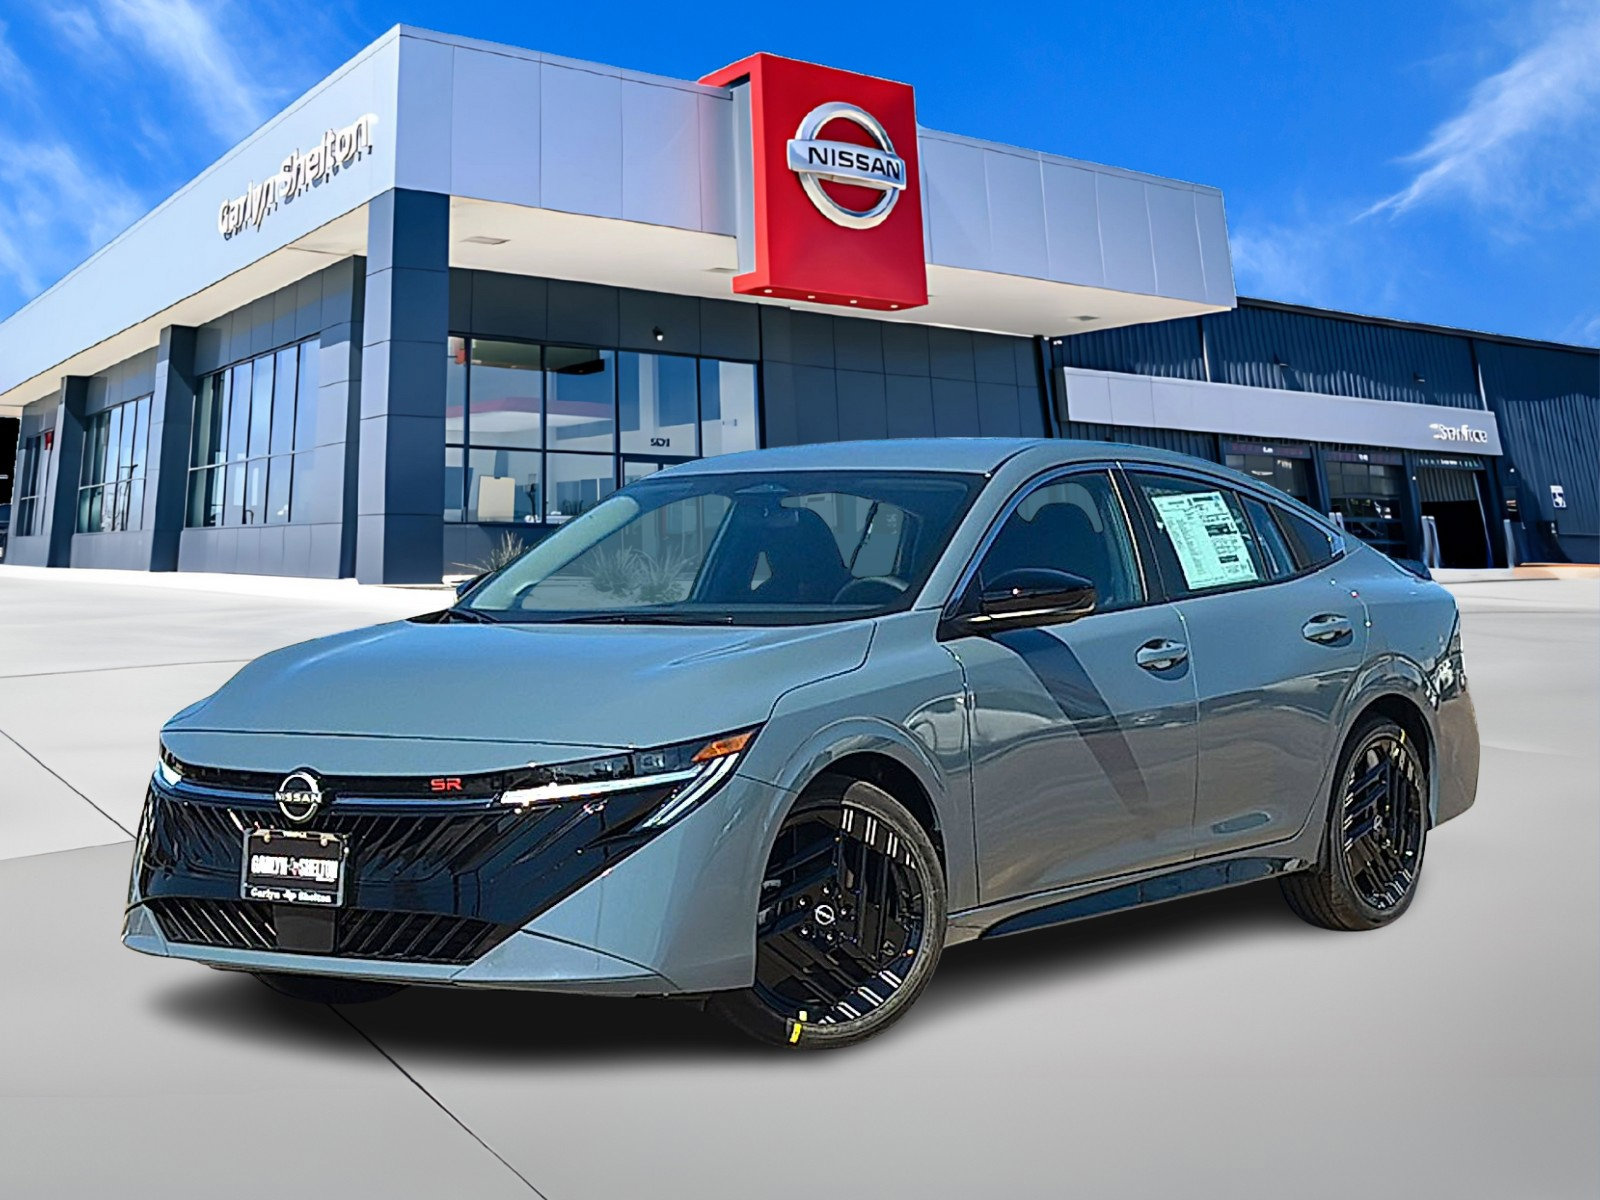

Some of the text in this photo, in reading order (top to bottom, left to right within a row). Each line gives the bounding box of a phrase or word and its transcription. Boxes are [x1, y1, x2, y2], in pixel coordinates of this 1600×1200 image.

[808, 146, 900, 181] NISSAN
[218, 114, 375, 238] Garlyn Shelton
[430, 777, 463, 790] SR
[275, 791, 322, 803] NISSAN
